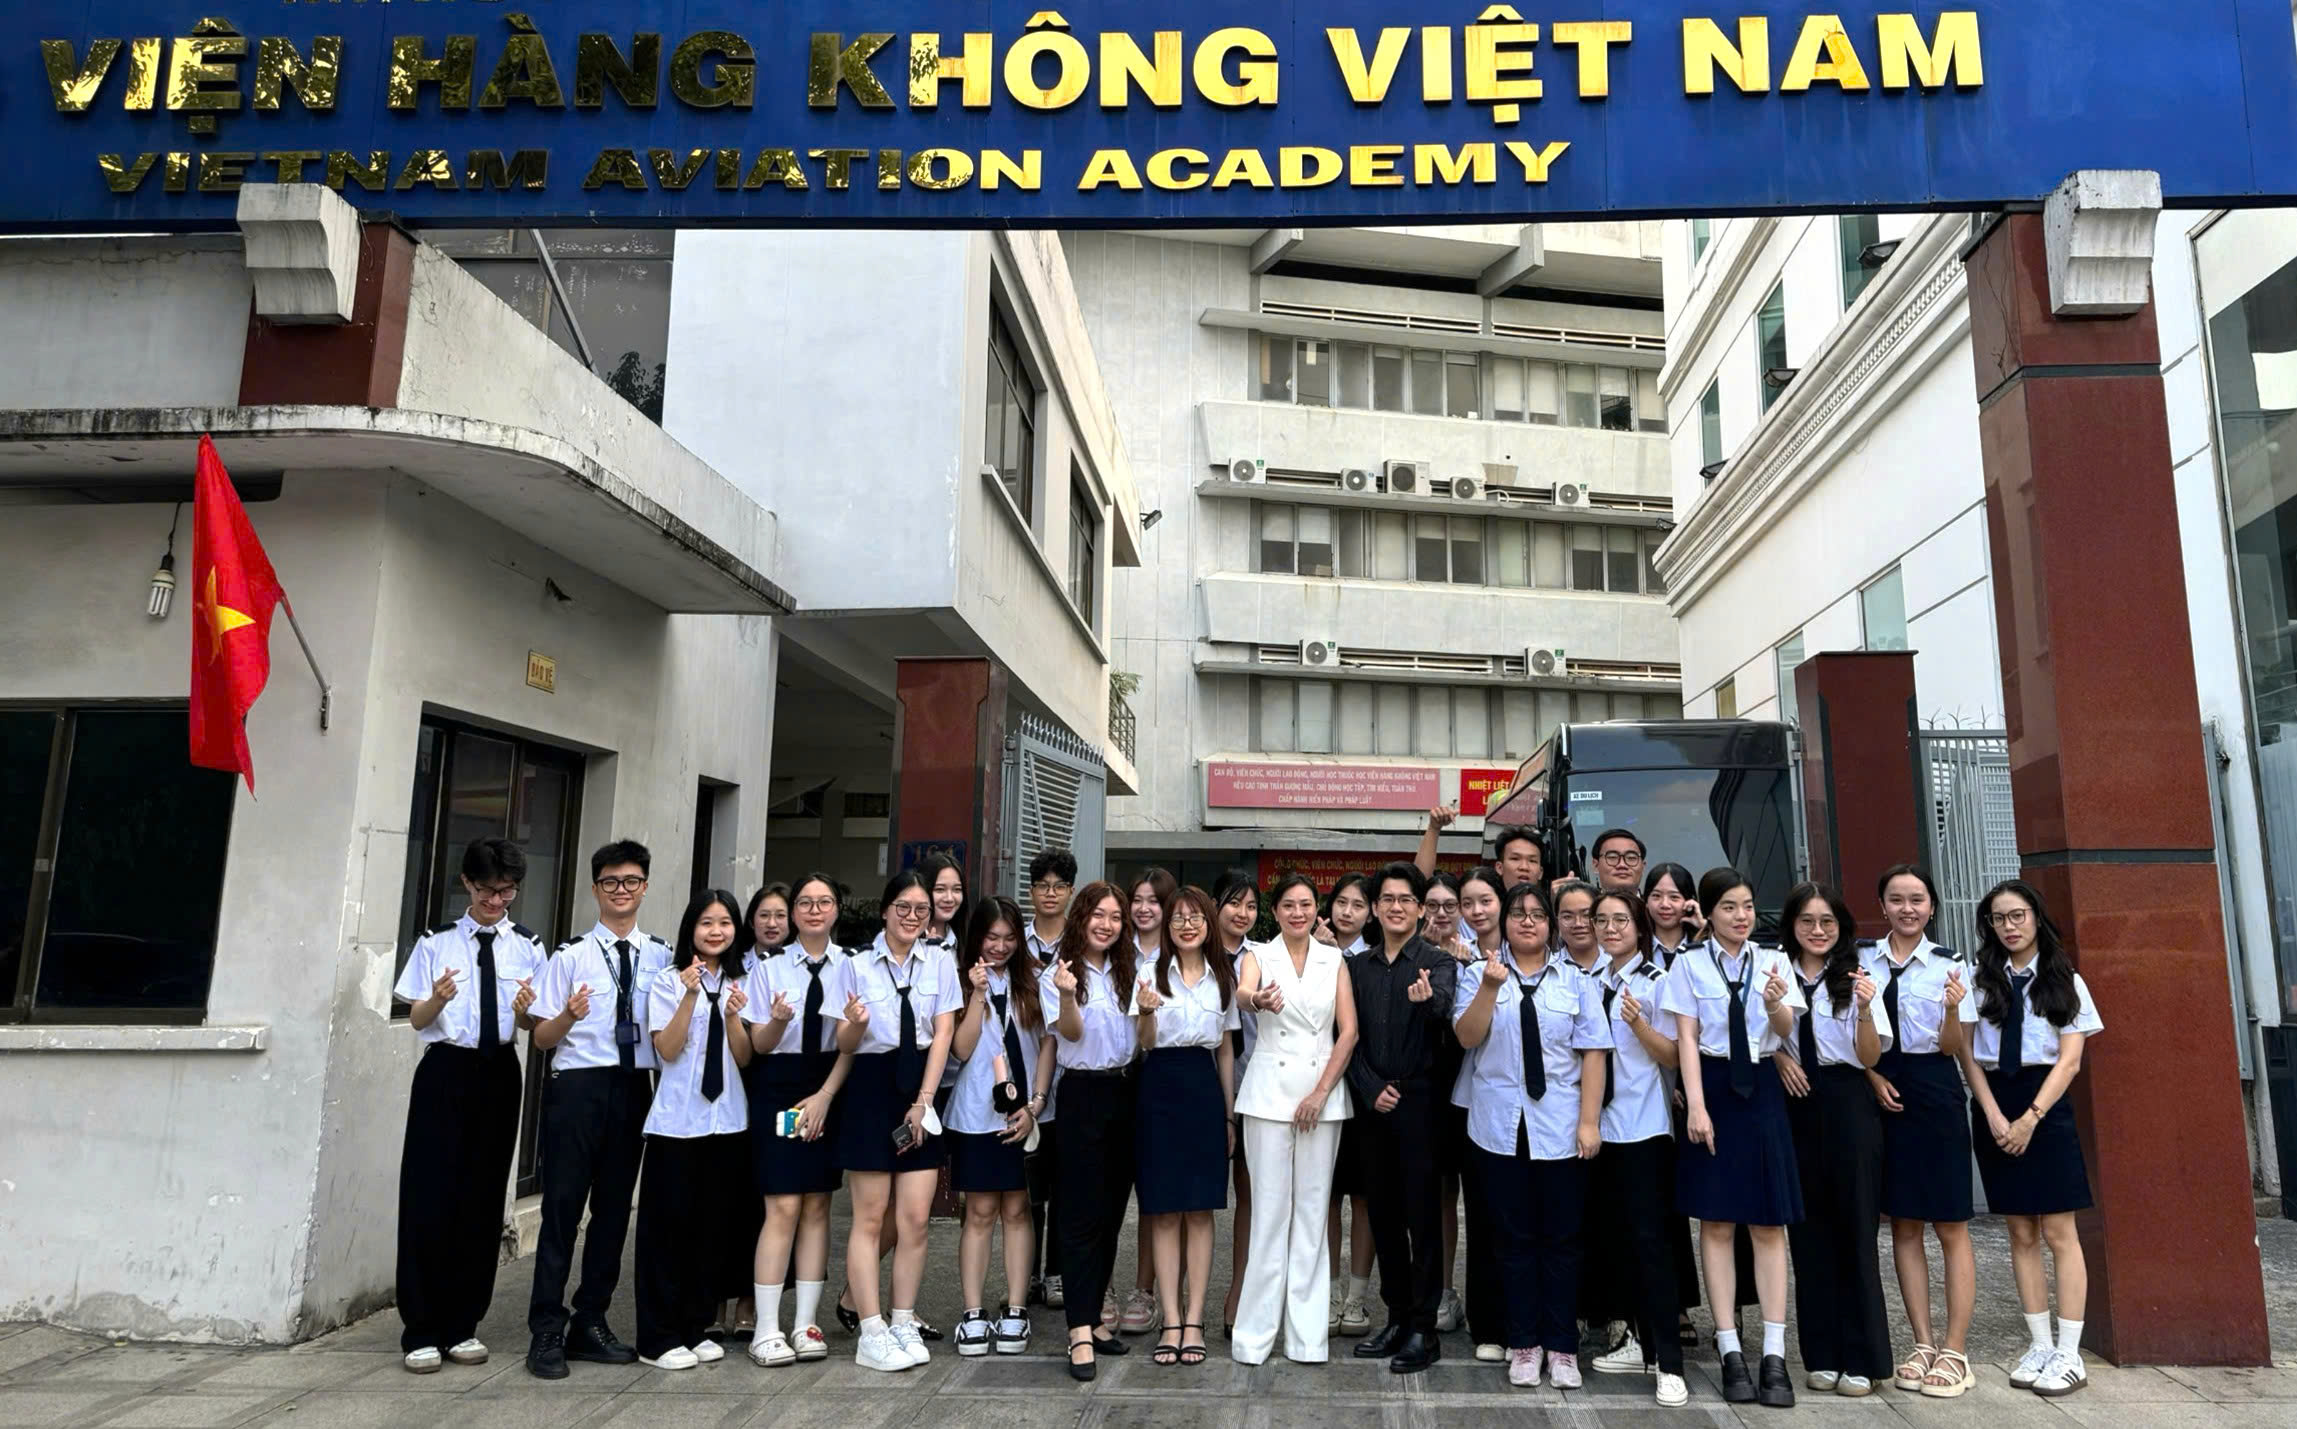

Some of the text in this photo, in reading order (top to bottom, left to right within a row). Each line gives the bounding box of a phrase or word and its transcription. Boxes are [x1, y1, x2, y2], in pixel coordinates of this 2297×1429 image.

[41, 4, 1985, 135] VIỆN HÀNG KHÔNG VIỆT NAM
[98, 141, 1572, 193] VIETNAM AVIATION ACADEMY
